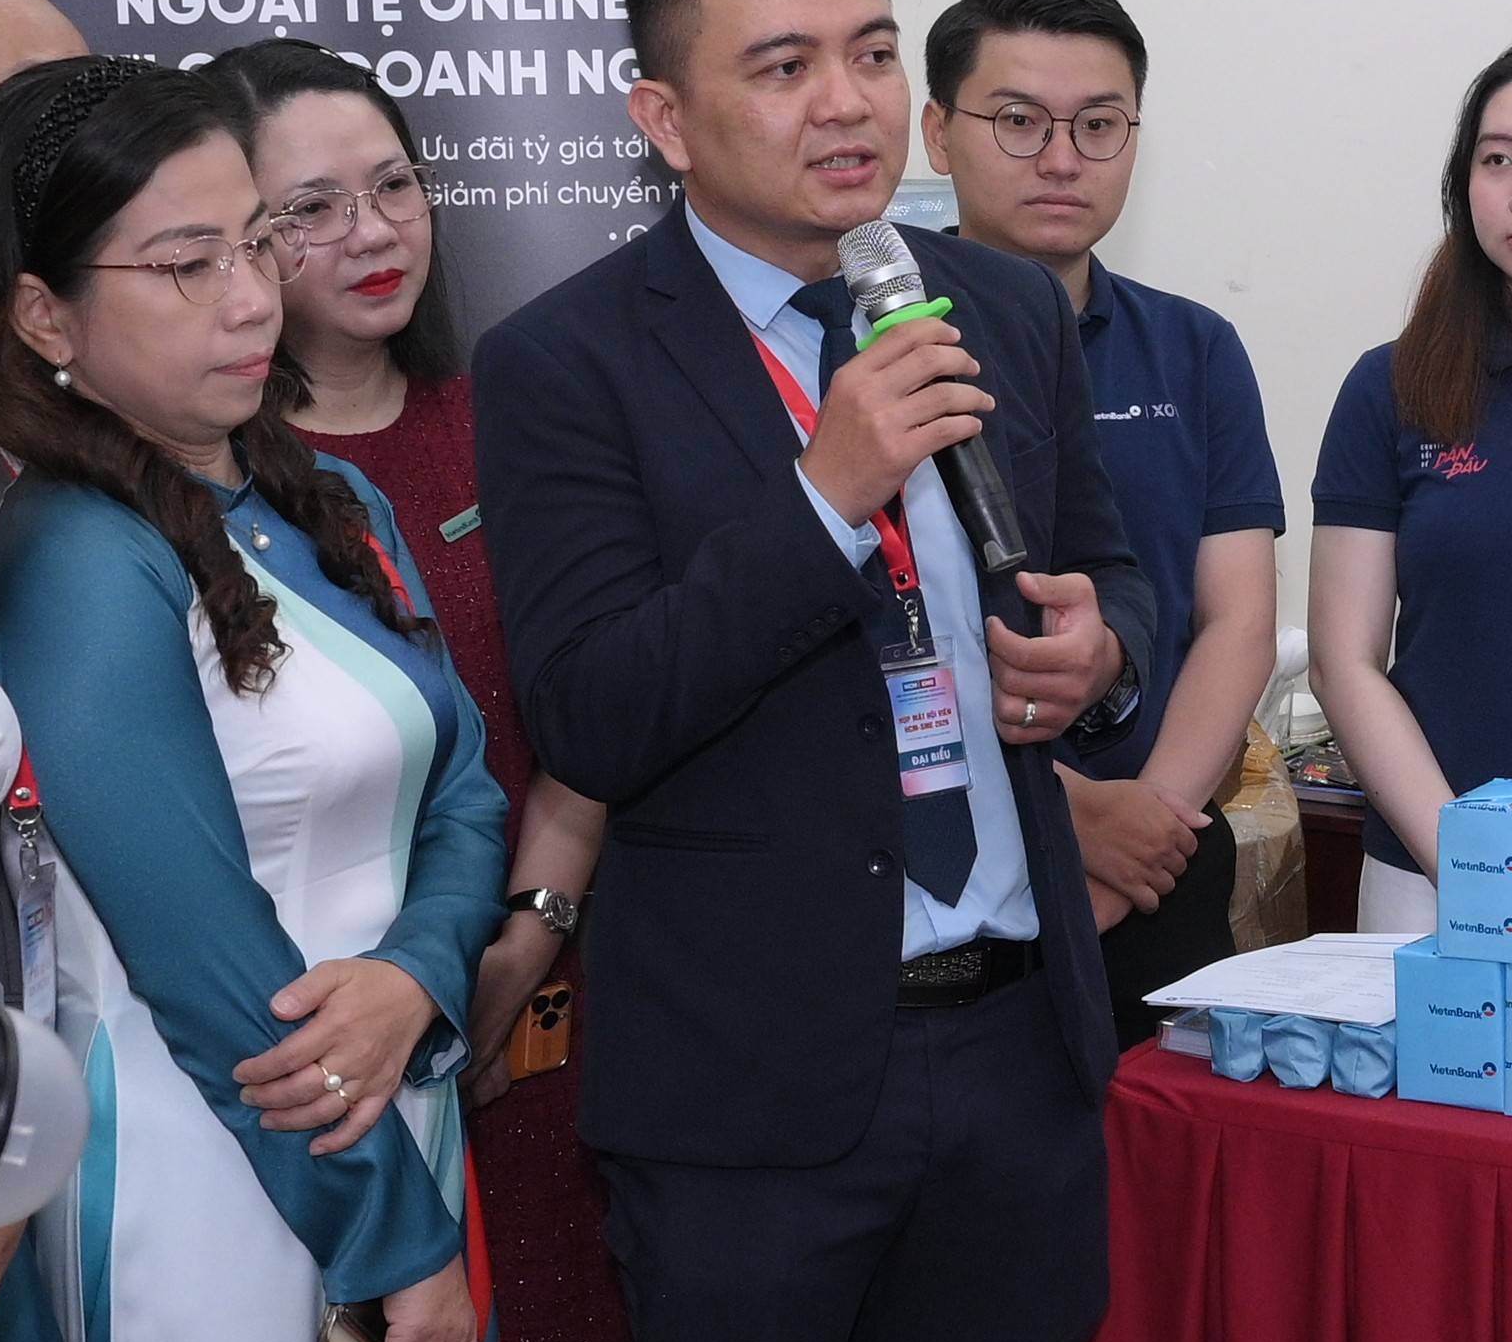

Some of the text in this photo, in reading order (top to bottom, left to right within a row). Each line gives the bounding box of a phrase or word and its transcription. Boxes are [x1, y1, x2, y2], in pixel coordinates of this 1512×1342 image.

[567, 50, 642, 95] NG
[421, 134, 650, 166] Ưu đãi tỷ giá tới
[505, 180, 549, 211] phí
[557, 176, 661, 210] chuyển
[911, 753, 930, 767] ĐẠI
[1451, 858, 1505, 875] VietinBank
[1449, 919, 1504, 936] VietinBank
[1428, 1003, 1483, 1020] VietinBank
[1429, 1063, 1484, 1080] VietinBank
